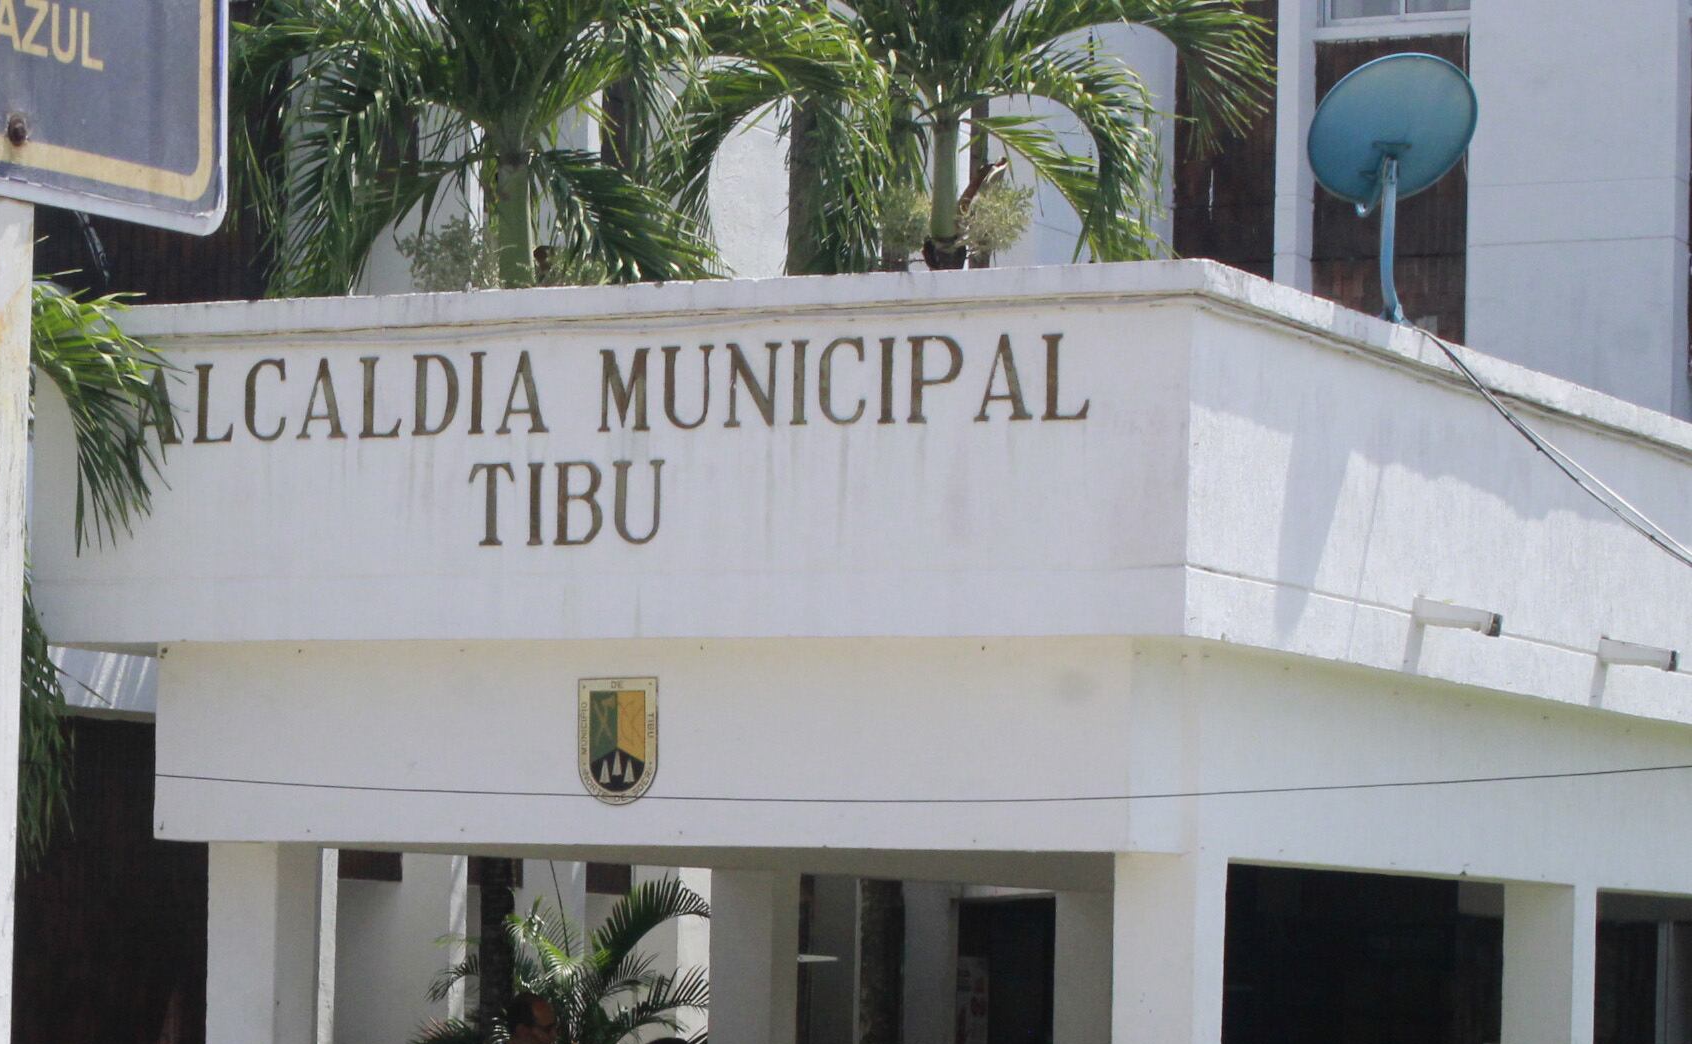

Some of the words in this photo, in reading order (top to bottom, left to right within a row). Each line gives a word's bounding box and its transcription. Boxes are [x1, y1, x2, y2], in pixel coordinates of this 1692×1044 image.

[138, 350, 549, 445] ALCALDIA
[597, 333, 1091, 434] MUNICIPAL
[469, 459, 666, 547] TIBU
[611, 681, 624, 689] DE
